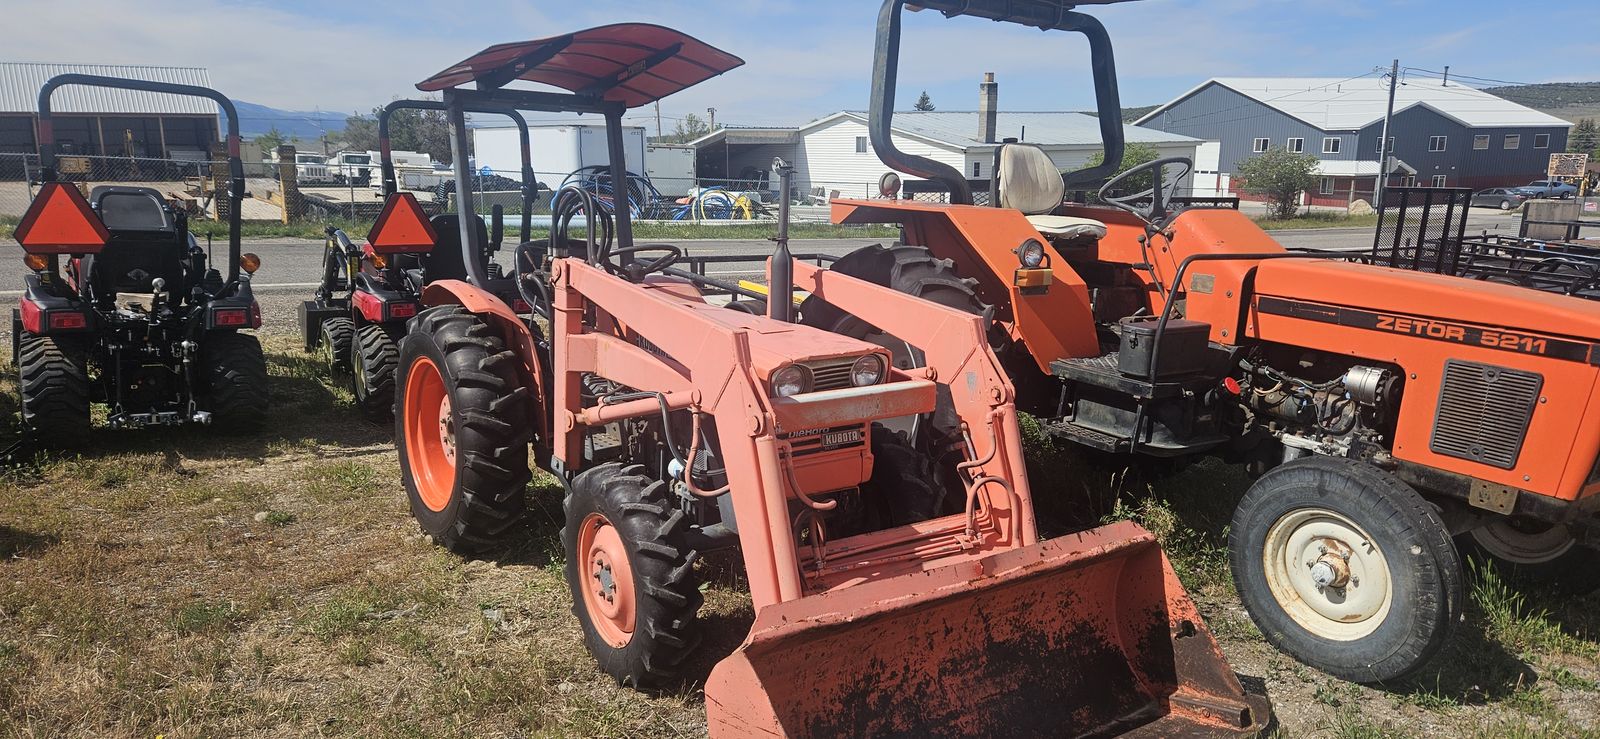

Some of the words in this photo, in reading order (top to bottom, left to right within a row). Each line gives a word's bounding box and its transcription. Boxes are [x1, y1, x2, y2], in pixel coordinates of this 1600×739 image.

[1376, 316, 1465, 341] ZETOR
[1480, 331, 1547, 354] 5211
[824, 430, 858, 445] KUBOTA
